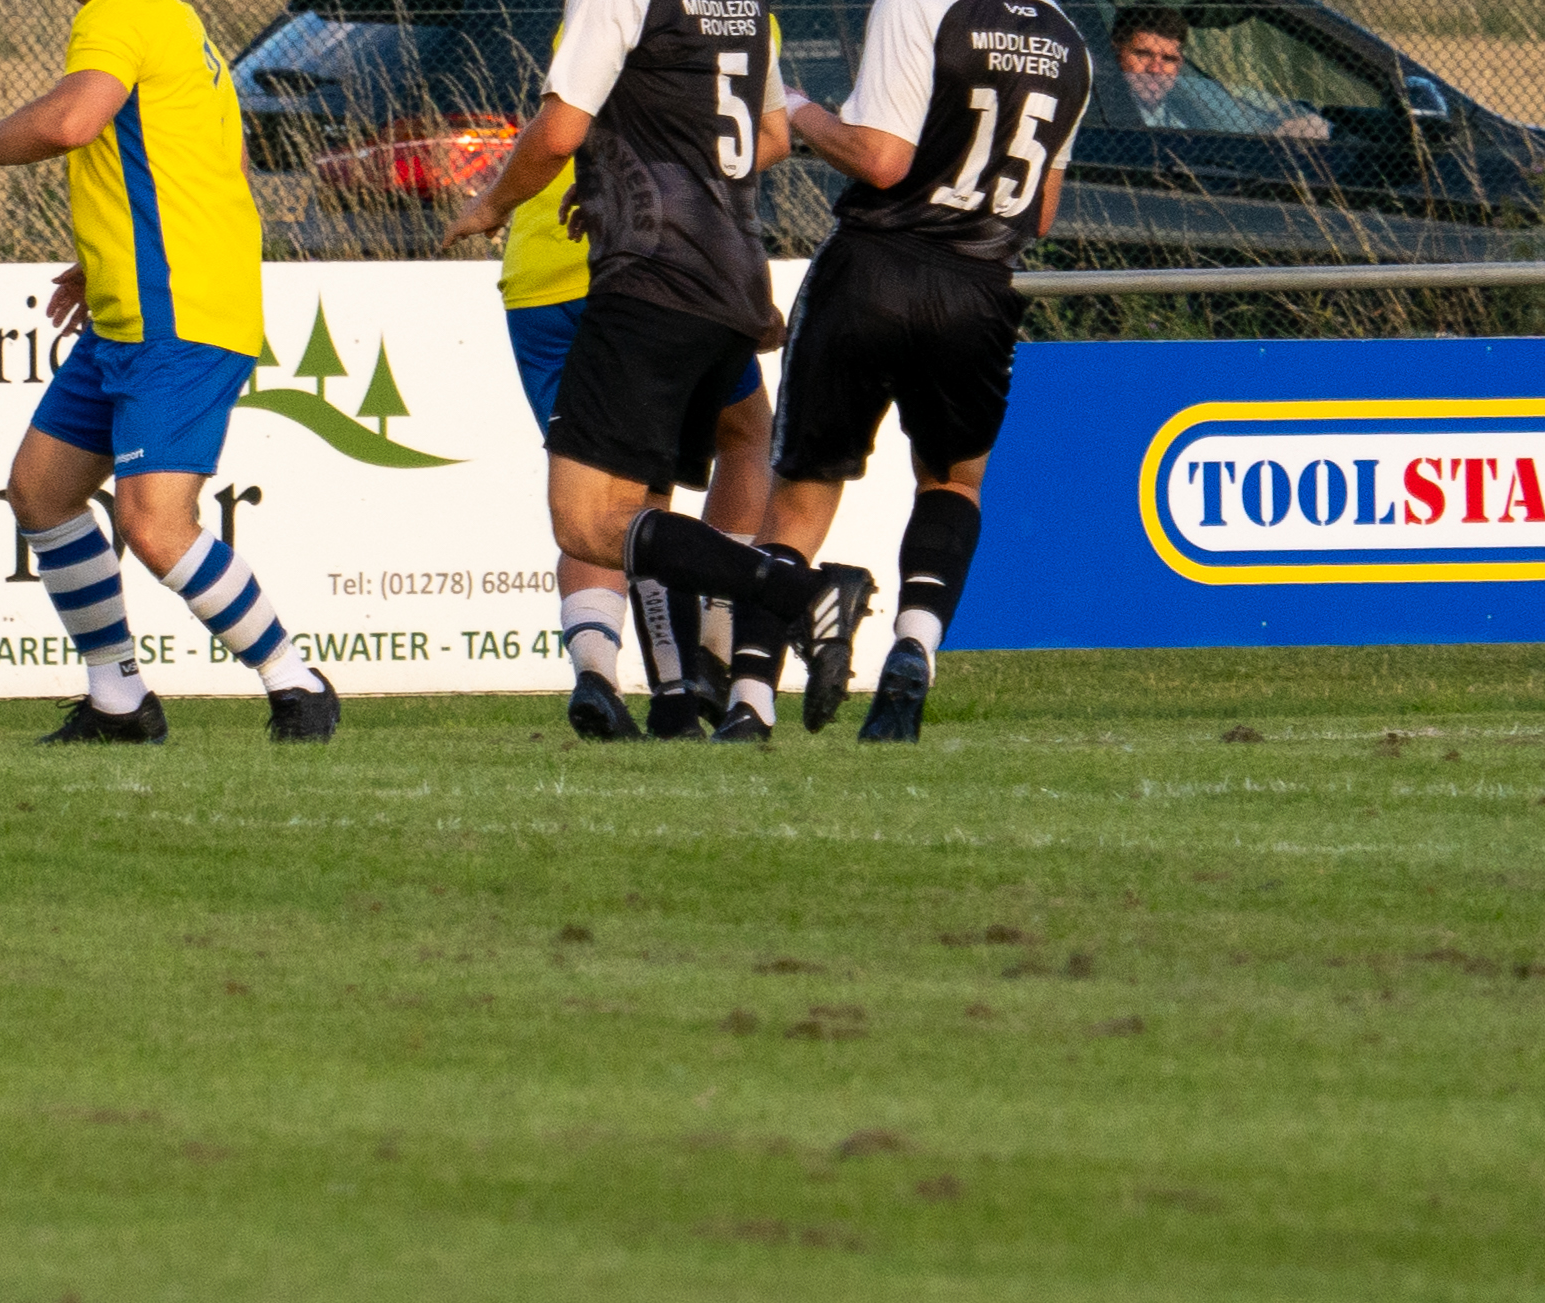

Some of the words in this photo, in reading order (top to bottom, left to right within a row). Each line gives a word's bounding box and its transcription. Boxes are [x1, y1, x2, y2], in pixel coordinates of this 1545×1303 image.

[700, 17, 757, 36] ROVERS
[971, 31, 1070, 63] MIDDLEZOY
[988, 52, 1060, 79] ROVERS
[717, 52, 753, 180] 5
[930, 87, 1058, 218] 15
[1188, 457, 1545, 527] TOOLSTA
[328, 573, 372, 596] Tel:
[380, 571, 473, 600] (01278)
[461, 629, 521, 660] TA6
